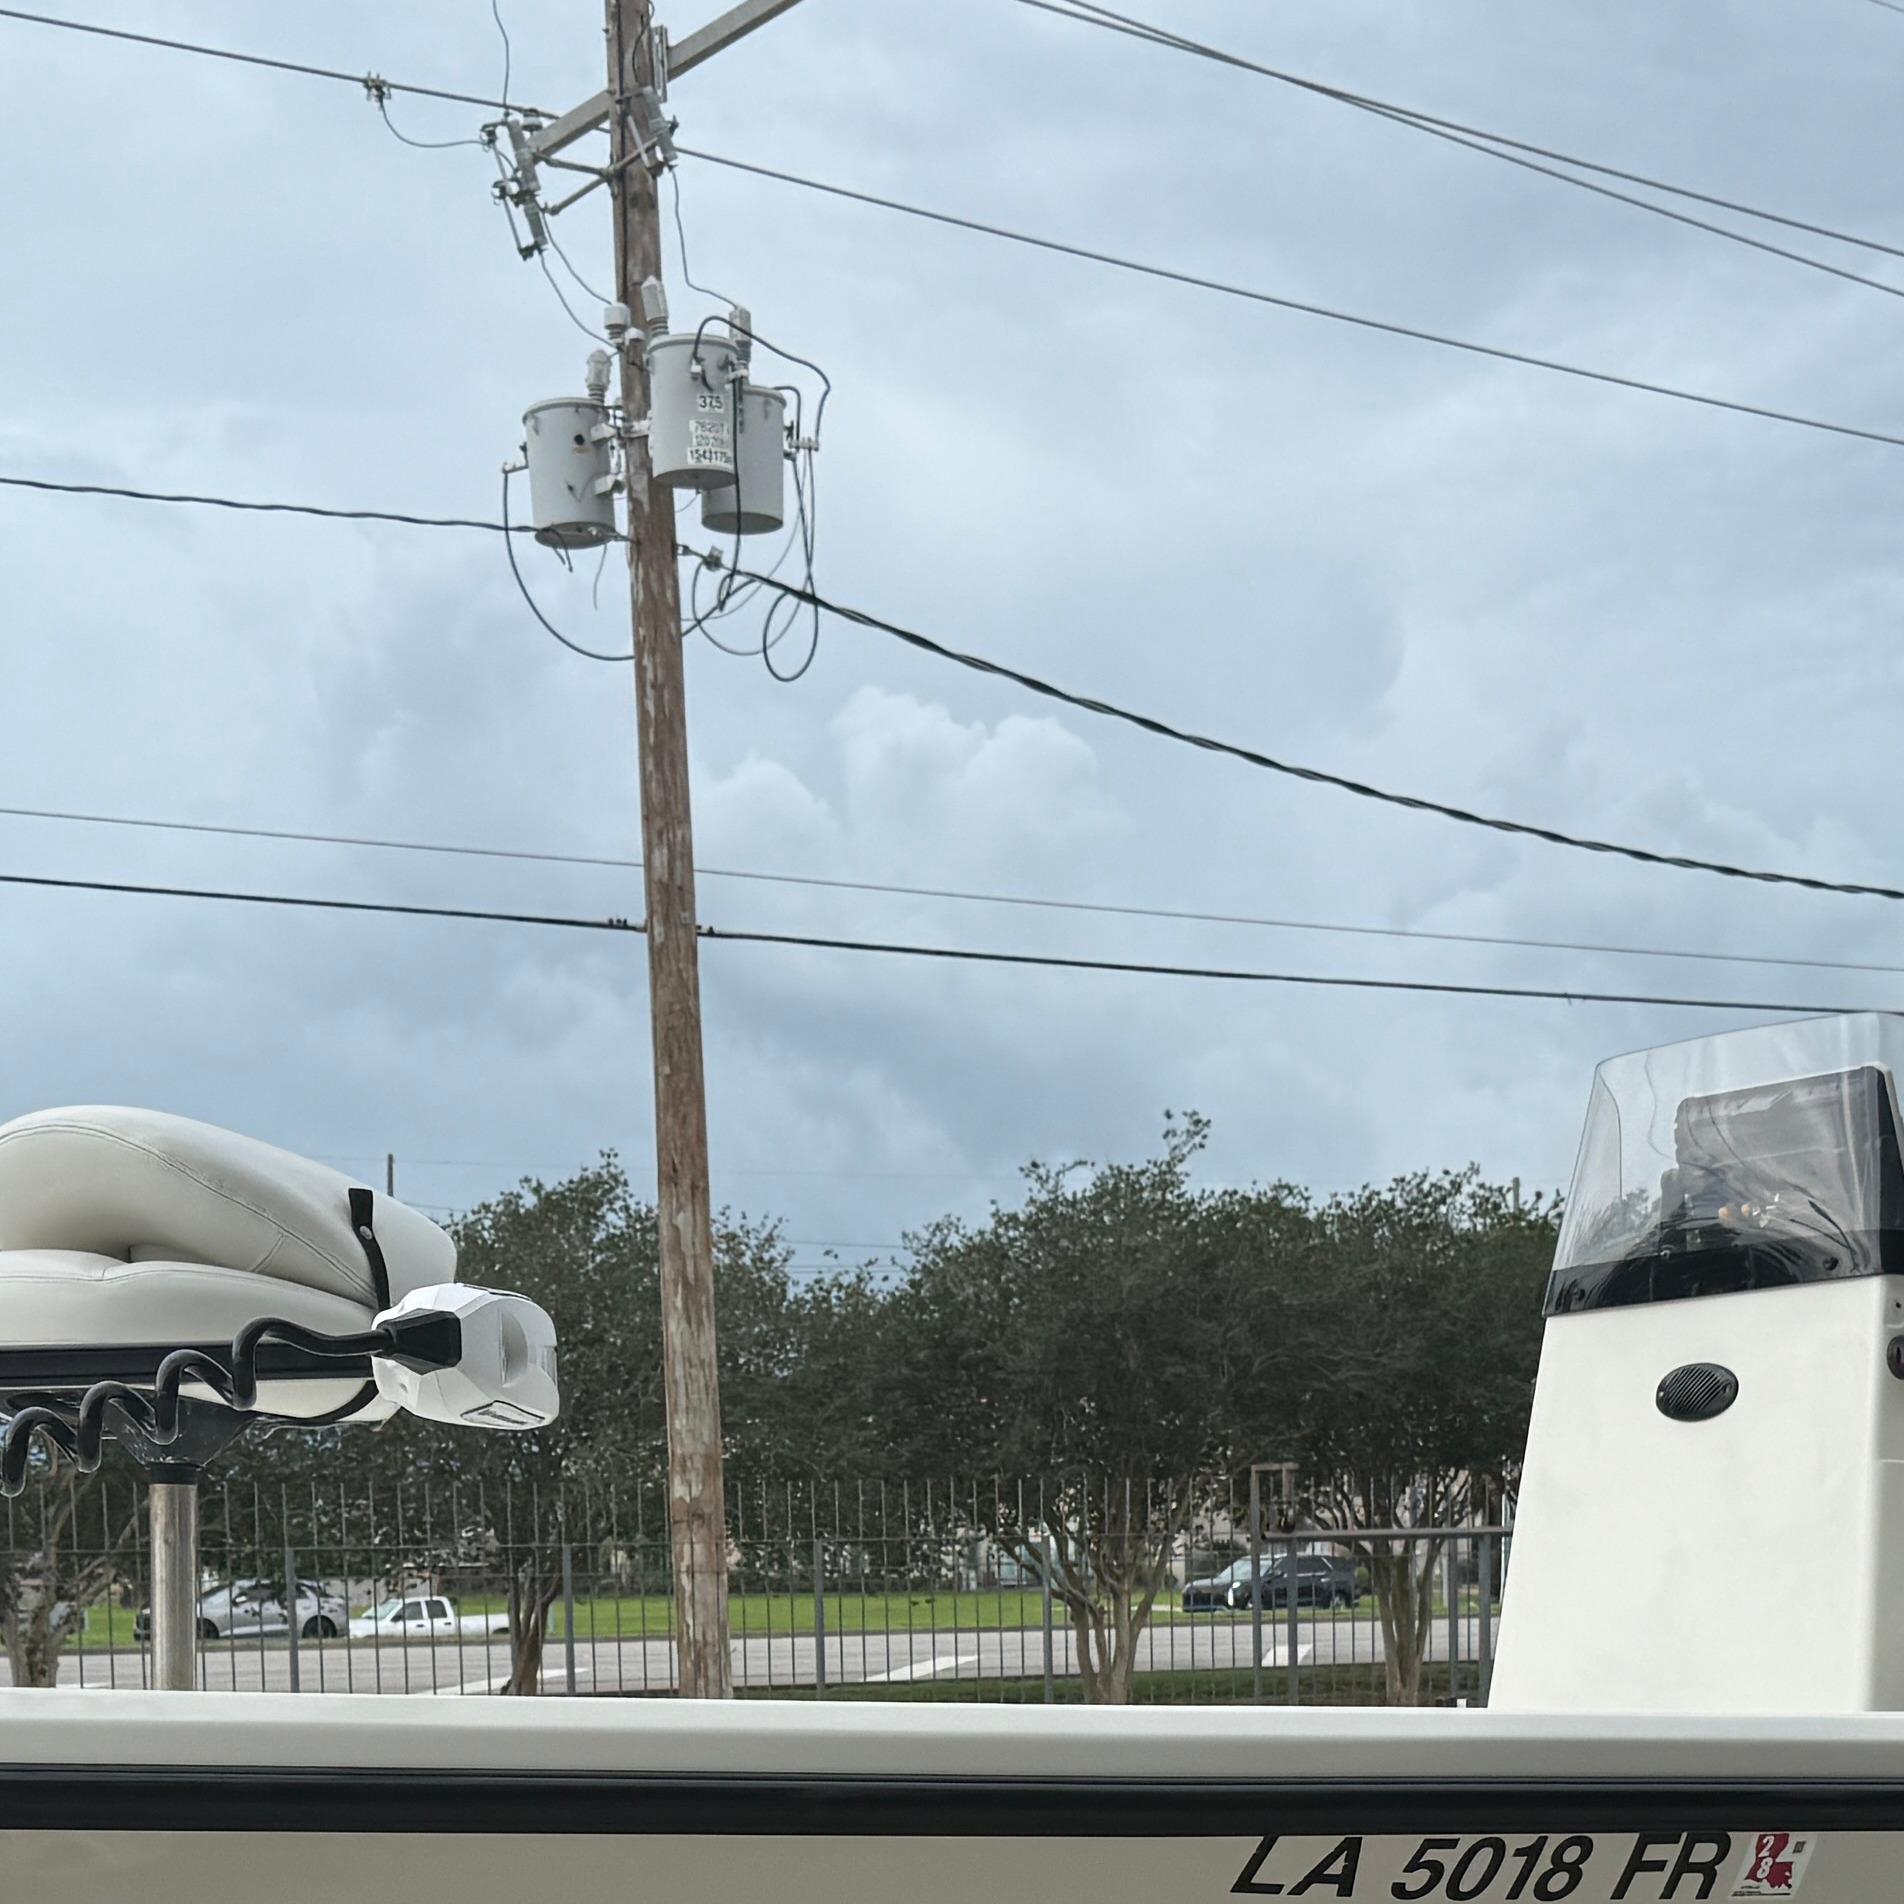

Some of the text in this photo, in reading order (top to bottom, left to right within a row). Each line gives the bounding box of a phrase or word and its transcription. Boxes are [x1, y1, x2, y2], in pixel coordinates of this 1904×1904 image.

[1230, 1830, 1733, 1902] LA 5018 FR
